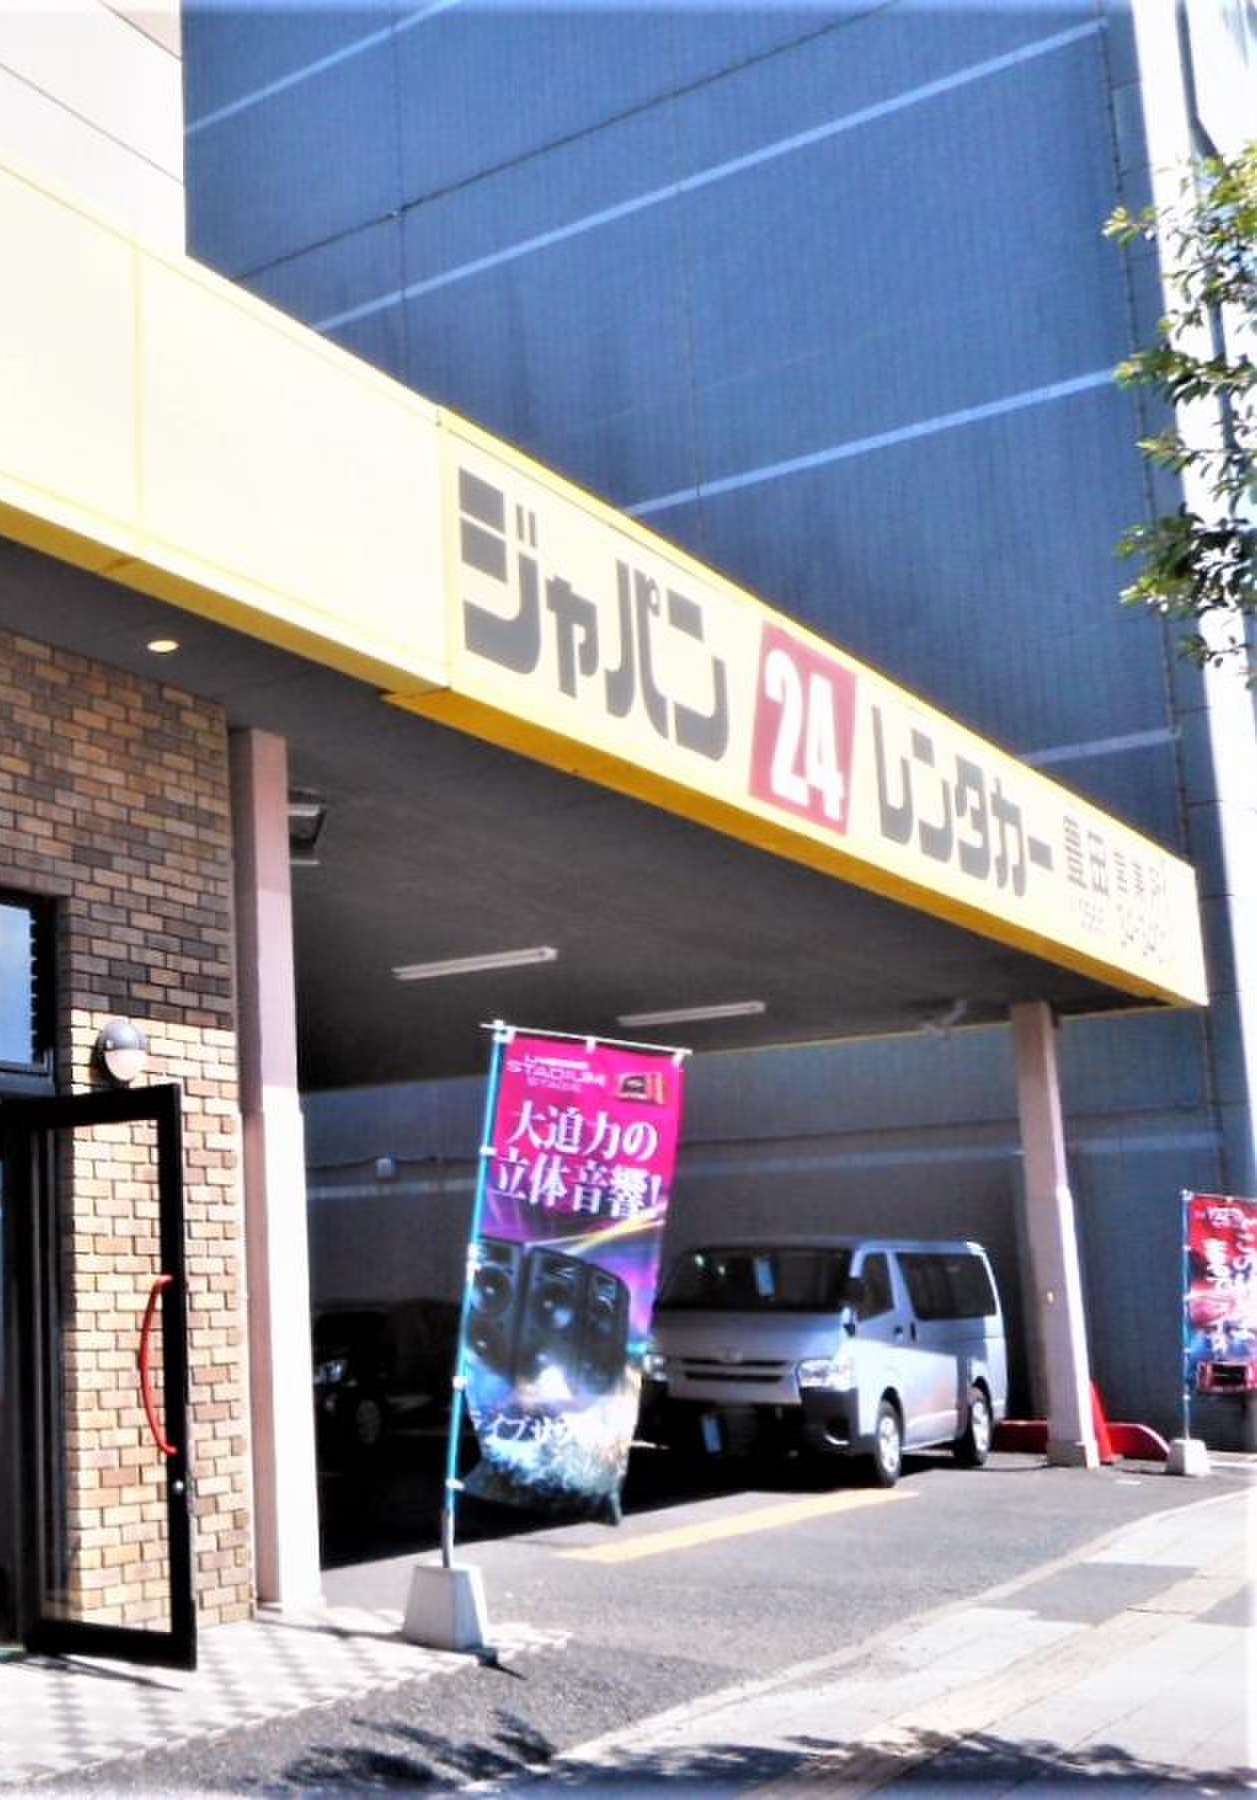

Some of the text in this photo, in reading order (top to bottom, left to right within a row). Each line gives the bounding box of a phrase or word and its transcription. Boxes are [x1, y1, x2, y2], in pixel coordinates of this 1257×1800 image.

[459, 466, 729, 762] ジャパン
[764, 649, 845, 822] 24
[872, 704, 1052, 897] レンタカー
[507, 1100, 658, 1161] 大迫力の
